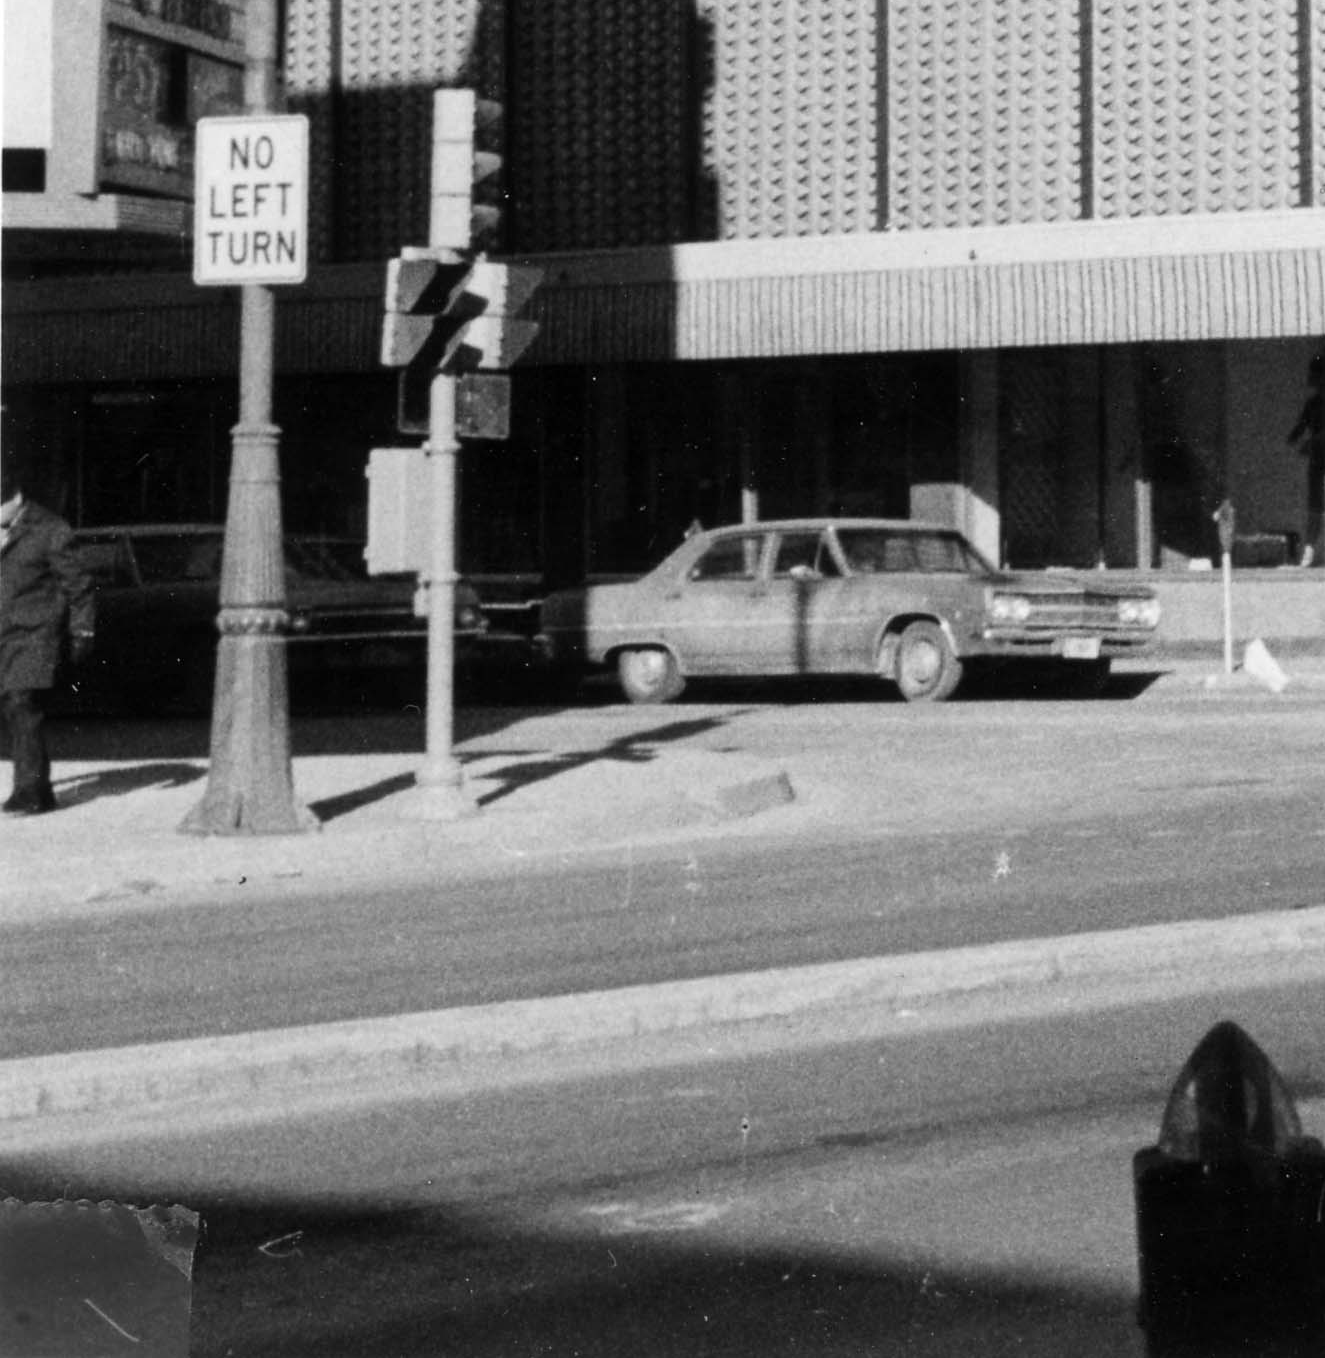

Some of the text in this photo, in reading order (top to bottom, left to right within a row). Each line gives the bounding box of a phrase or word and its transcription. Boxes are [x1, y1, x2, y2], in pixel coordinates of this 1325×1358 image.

[231, 136, 274, 170] NO
[210, 183, 293, 218] LEFT
[208, 230, 296, 264] TURN
